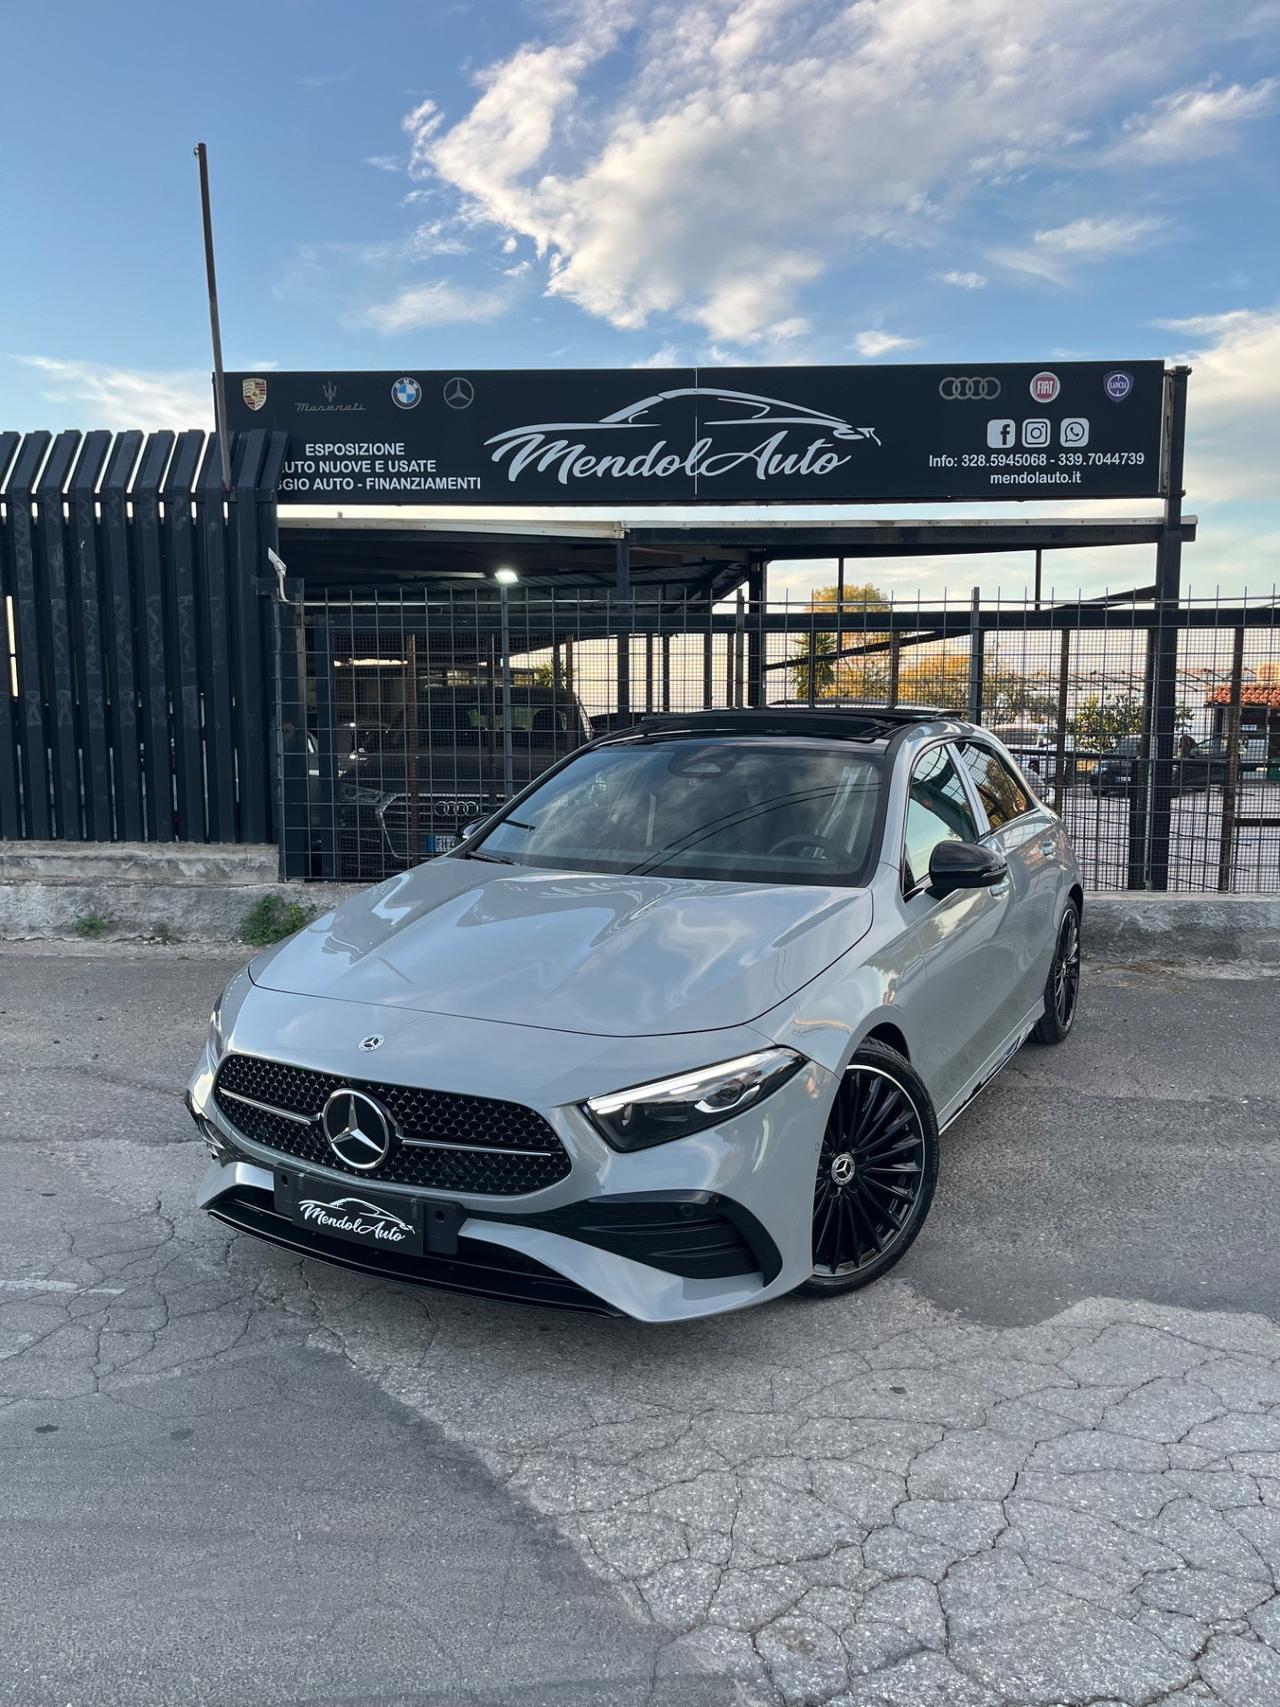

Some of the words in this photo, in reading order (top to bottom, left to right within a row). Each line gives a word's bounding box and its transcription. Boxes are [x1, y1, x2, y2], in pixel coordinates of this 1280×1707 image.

[1037, 380, 1054, 395] FIAT
[294, 402, 367, 412] Maserati
[305, 442, 405, 456] ESPOSIZIONE
[282, 461, 316, 473] UTO
[319, 460, 371, 473] NUOVE
[375, 460, 385, 473] E
[388, 459, 437, 472] USATE
[929, 454, 958, 467] Info:
[961, 453, 1047, 467] 328.5945068
[1058, 452, 1145, 466] 339.7044739
[313, 478, 354, 491] AUTO
[366, 476, 481, 490] FINANZIAMENTI
[990, 471, 1082, 484] mendolauto.it
[300, 1203, 406, 1242] MendolAuto
